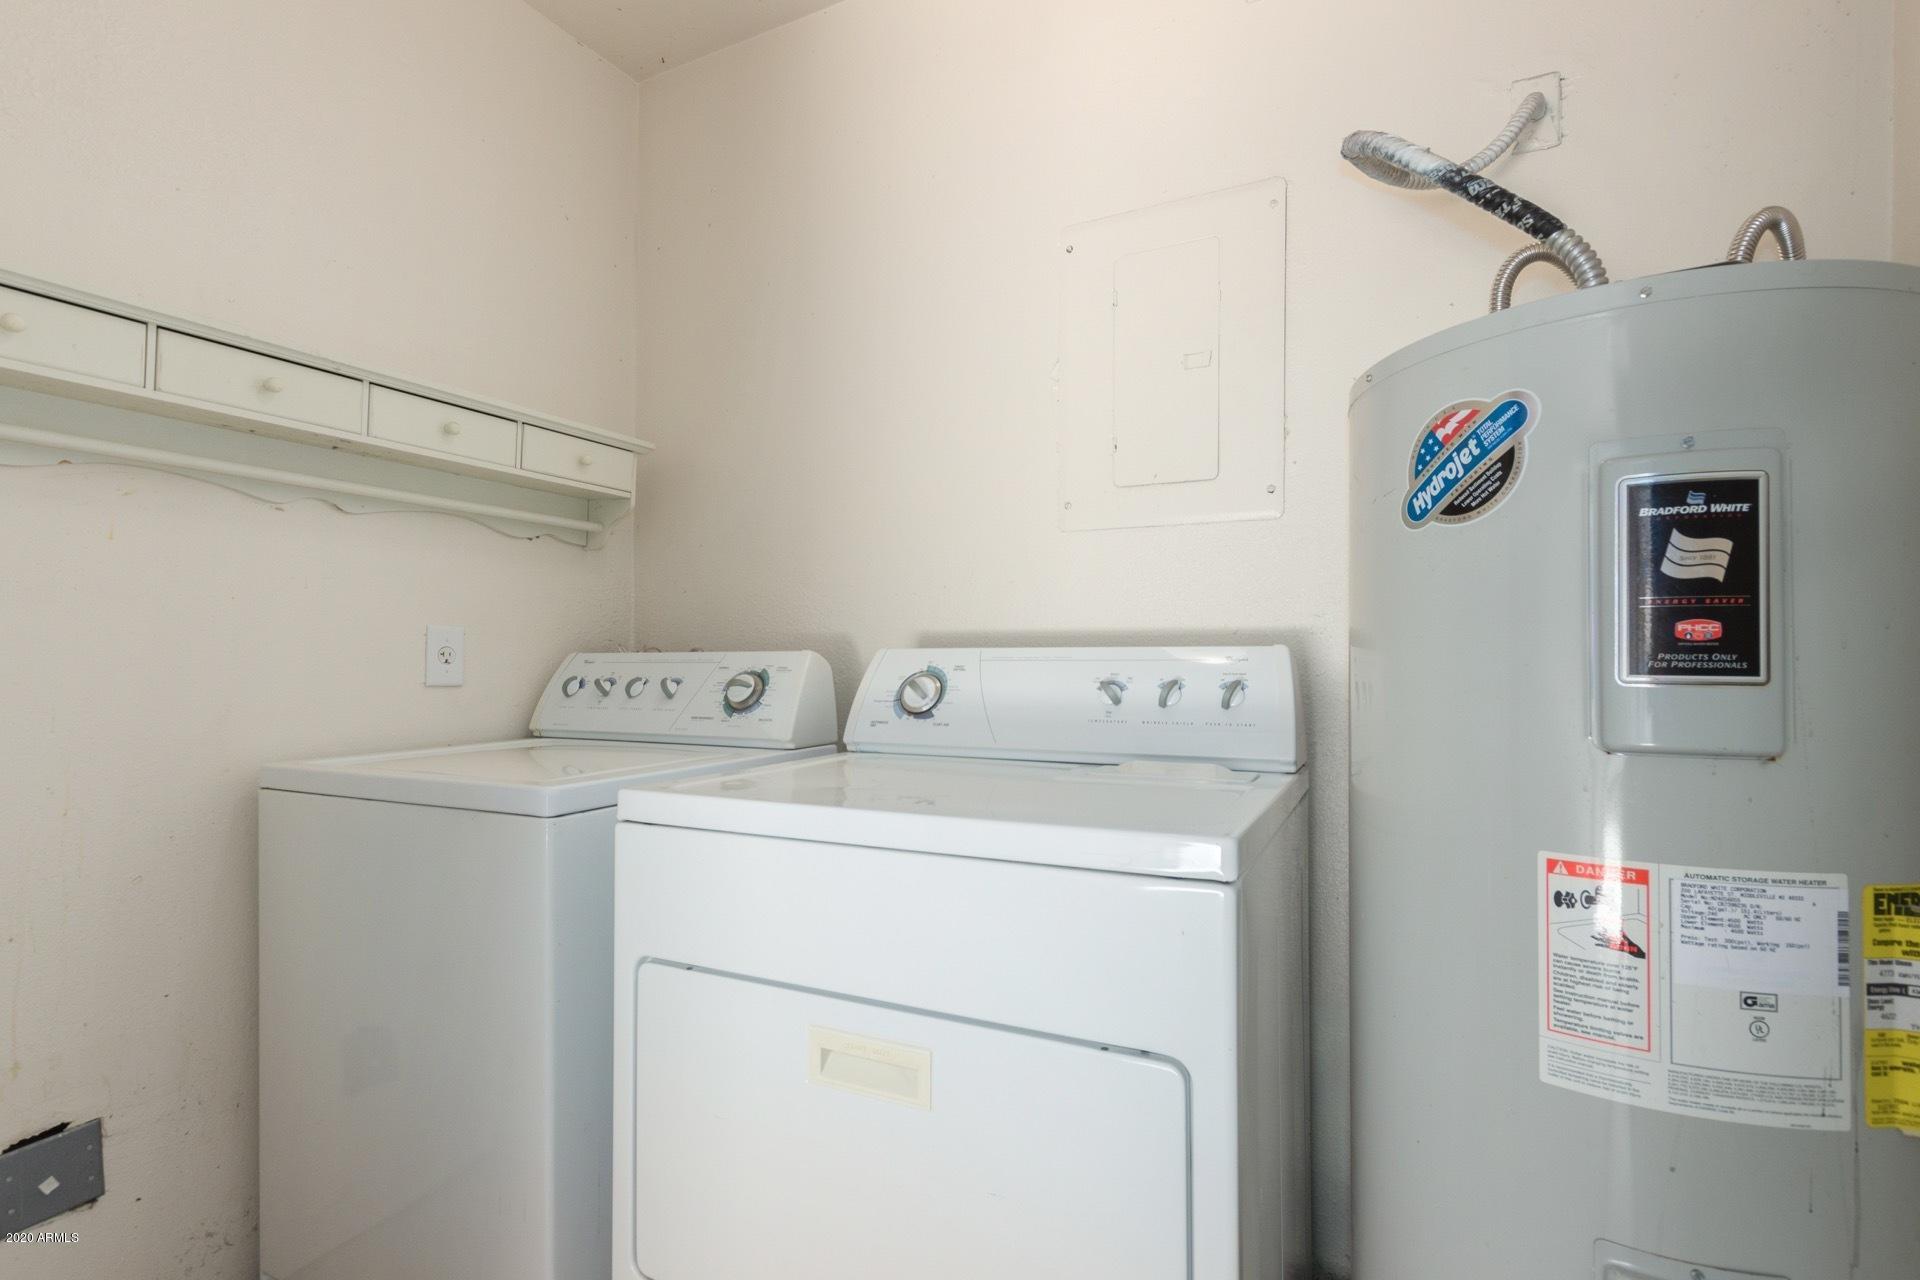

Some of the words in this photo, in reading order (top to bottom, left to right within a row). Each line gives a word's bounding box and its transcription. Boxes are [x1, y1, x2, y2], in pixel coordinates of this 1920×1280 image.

[1476, 420, 1494, 436] TOTAL
[1480, 404, 1520, 440] PERFORMANCE
[1484, 425, 1505, 447] SYSTEM
[1412, 436, 1480, 515] Hydrojet
[1638, 504, 1708, 517] BRADFORD
[1710, 503, 1751, 513] WHITE
[1658, 652, 1708, 660] PRODUCTS
[1670, 660, 1748, 668] PROFESSIONALS
[1576, 864, 1636, 880] DANER
[1684, 873, 1730, 881] AUTOMATIC
